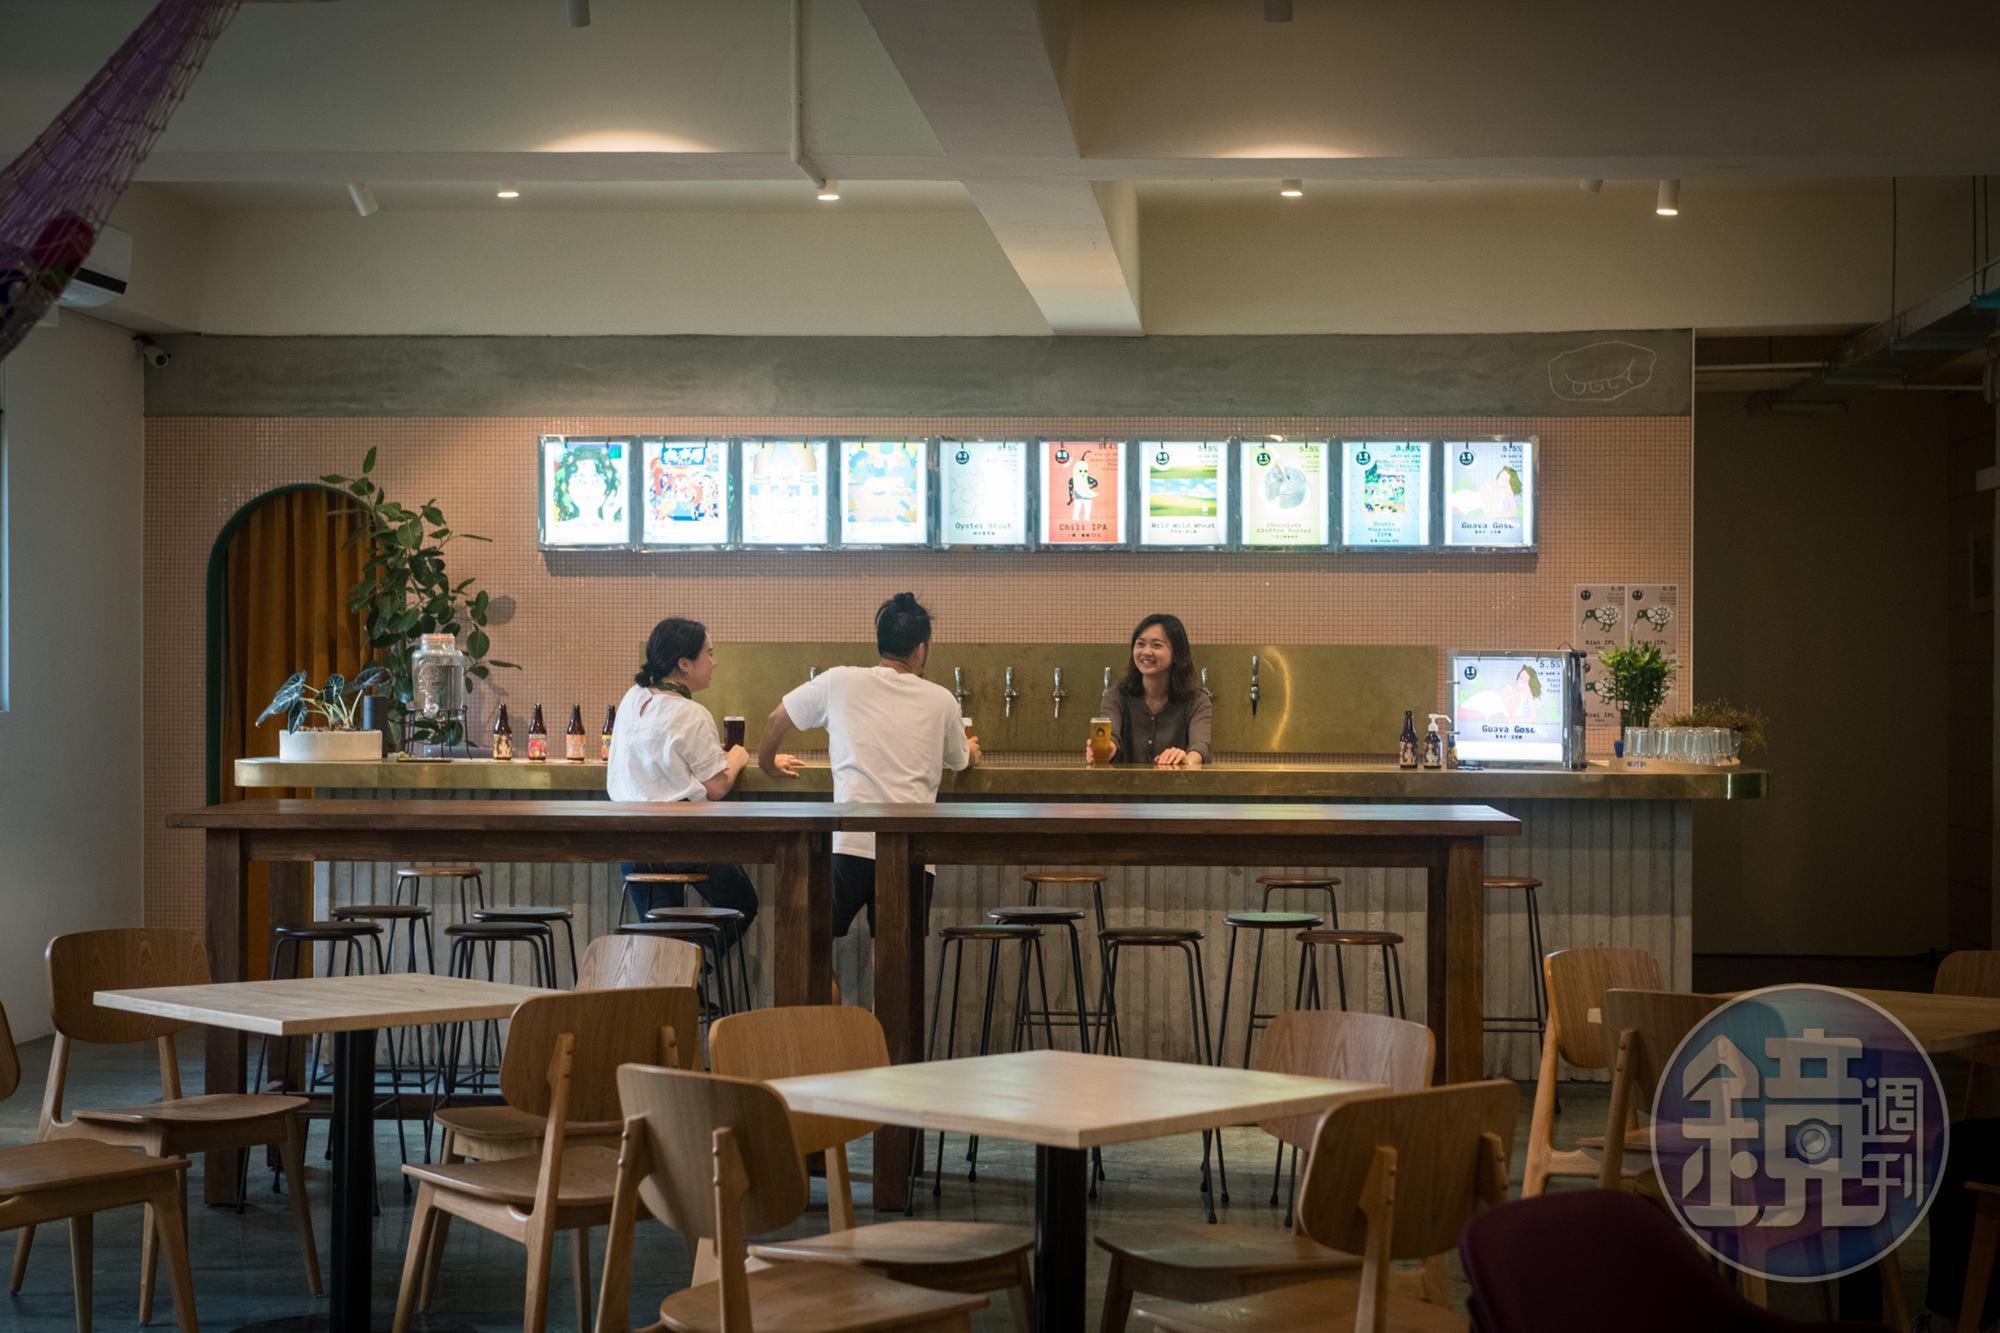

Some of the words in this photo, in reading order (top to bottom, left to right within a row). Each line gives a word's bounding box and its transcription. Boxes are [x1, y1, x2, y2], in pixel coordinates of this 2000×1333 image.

[955, 522, 983, 530] Oyster
[1059, 523, 1085, 531] Chili
[1092, 523, 1107, 531] IPA
[1482, 724, 1509, 733] Guava
[1514, 725, 1536, 734] Gose
